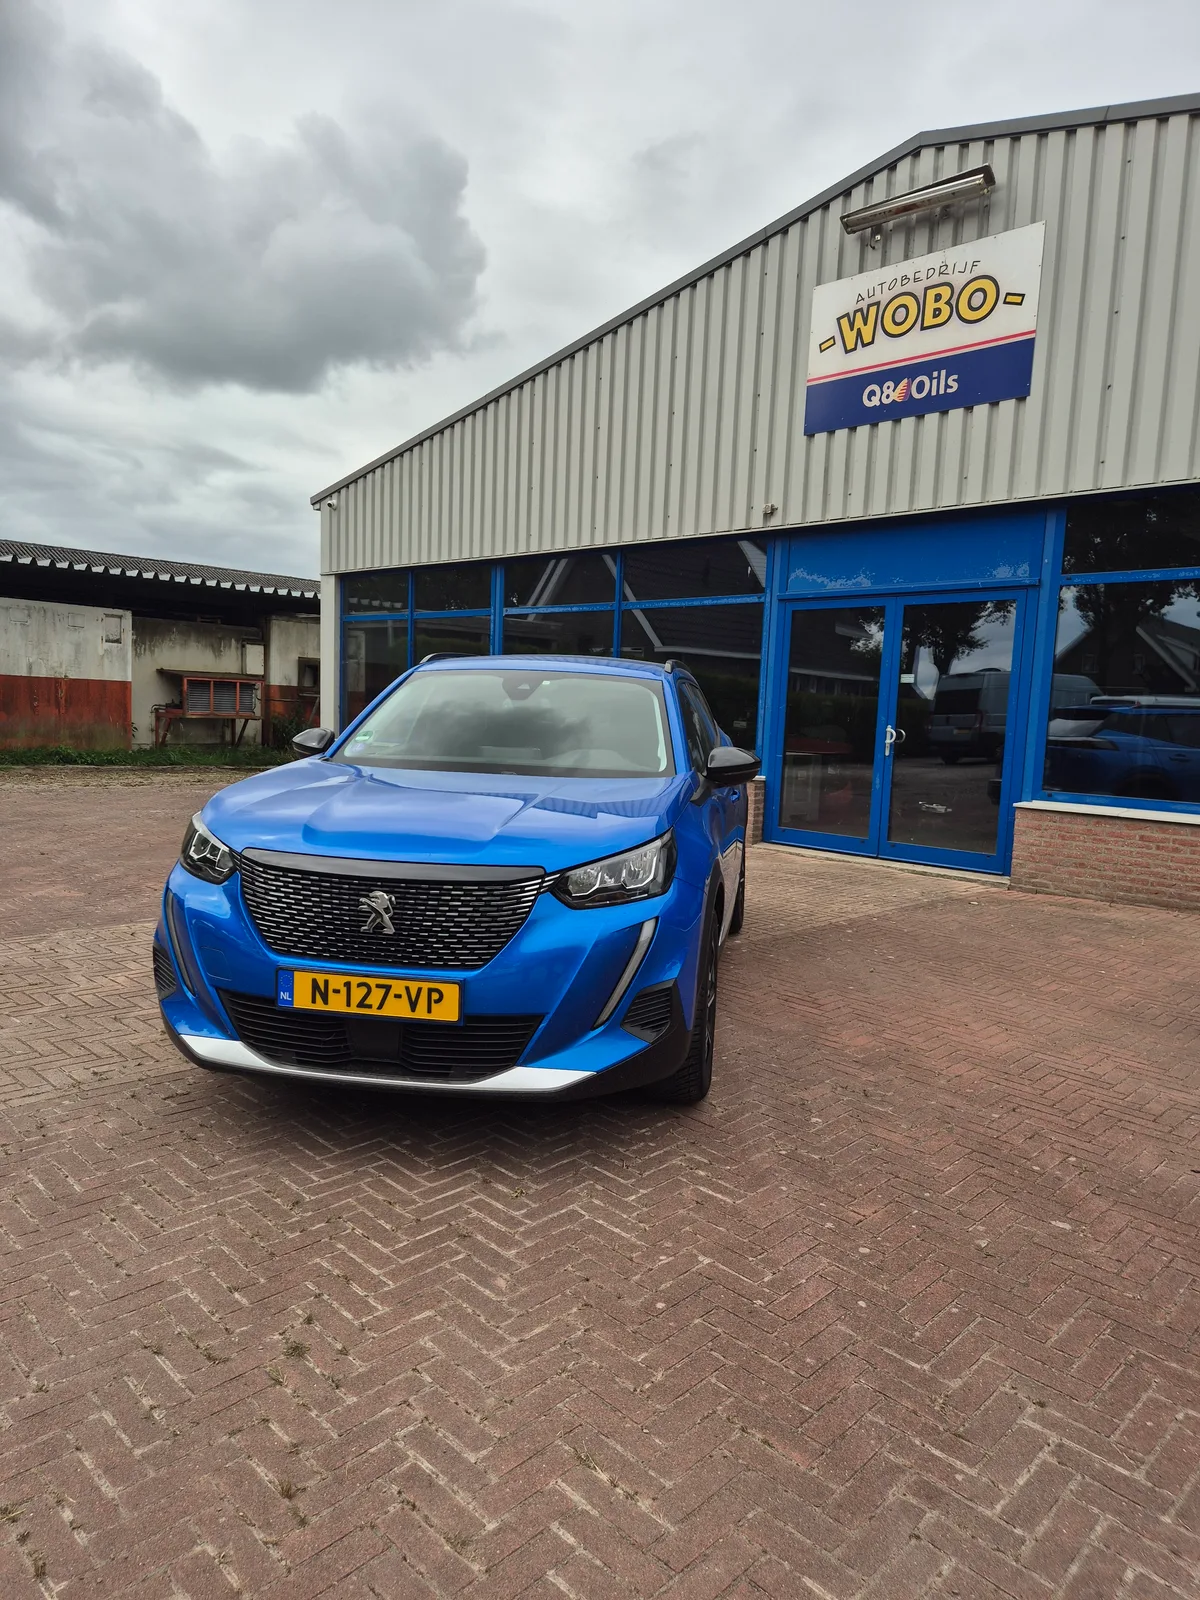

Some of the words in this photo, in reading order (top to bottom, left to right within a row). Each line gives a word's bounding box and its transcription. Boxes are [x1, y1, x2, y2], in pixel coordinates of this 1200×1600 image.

[856, 260, 981, 305] AUTOBEDRIJF
[862, 380, 895, 408] Q8
[911, 369, 959, 399] Oils
[280, 991, 292, 1001] NL
[311, 977, 444, 1014] N-127-VP
